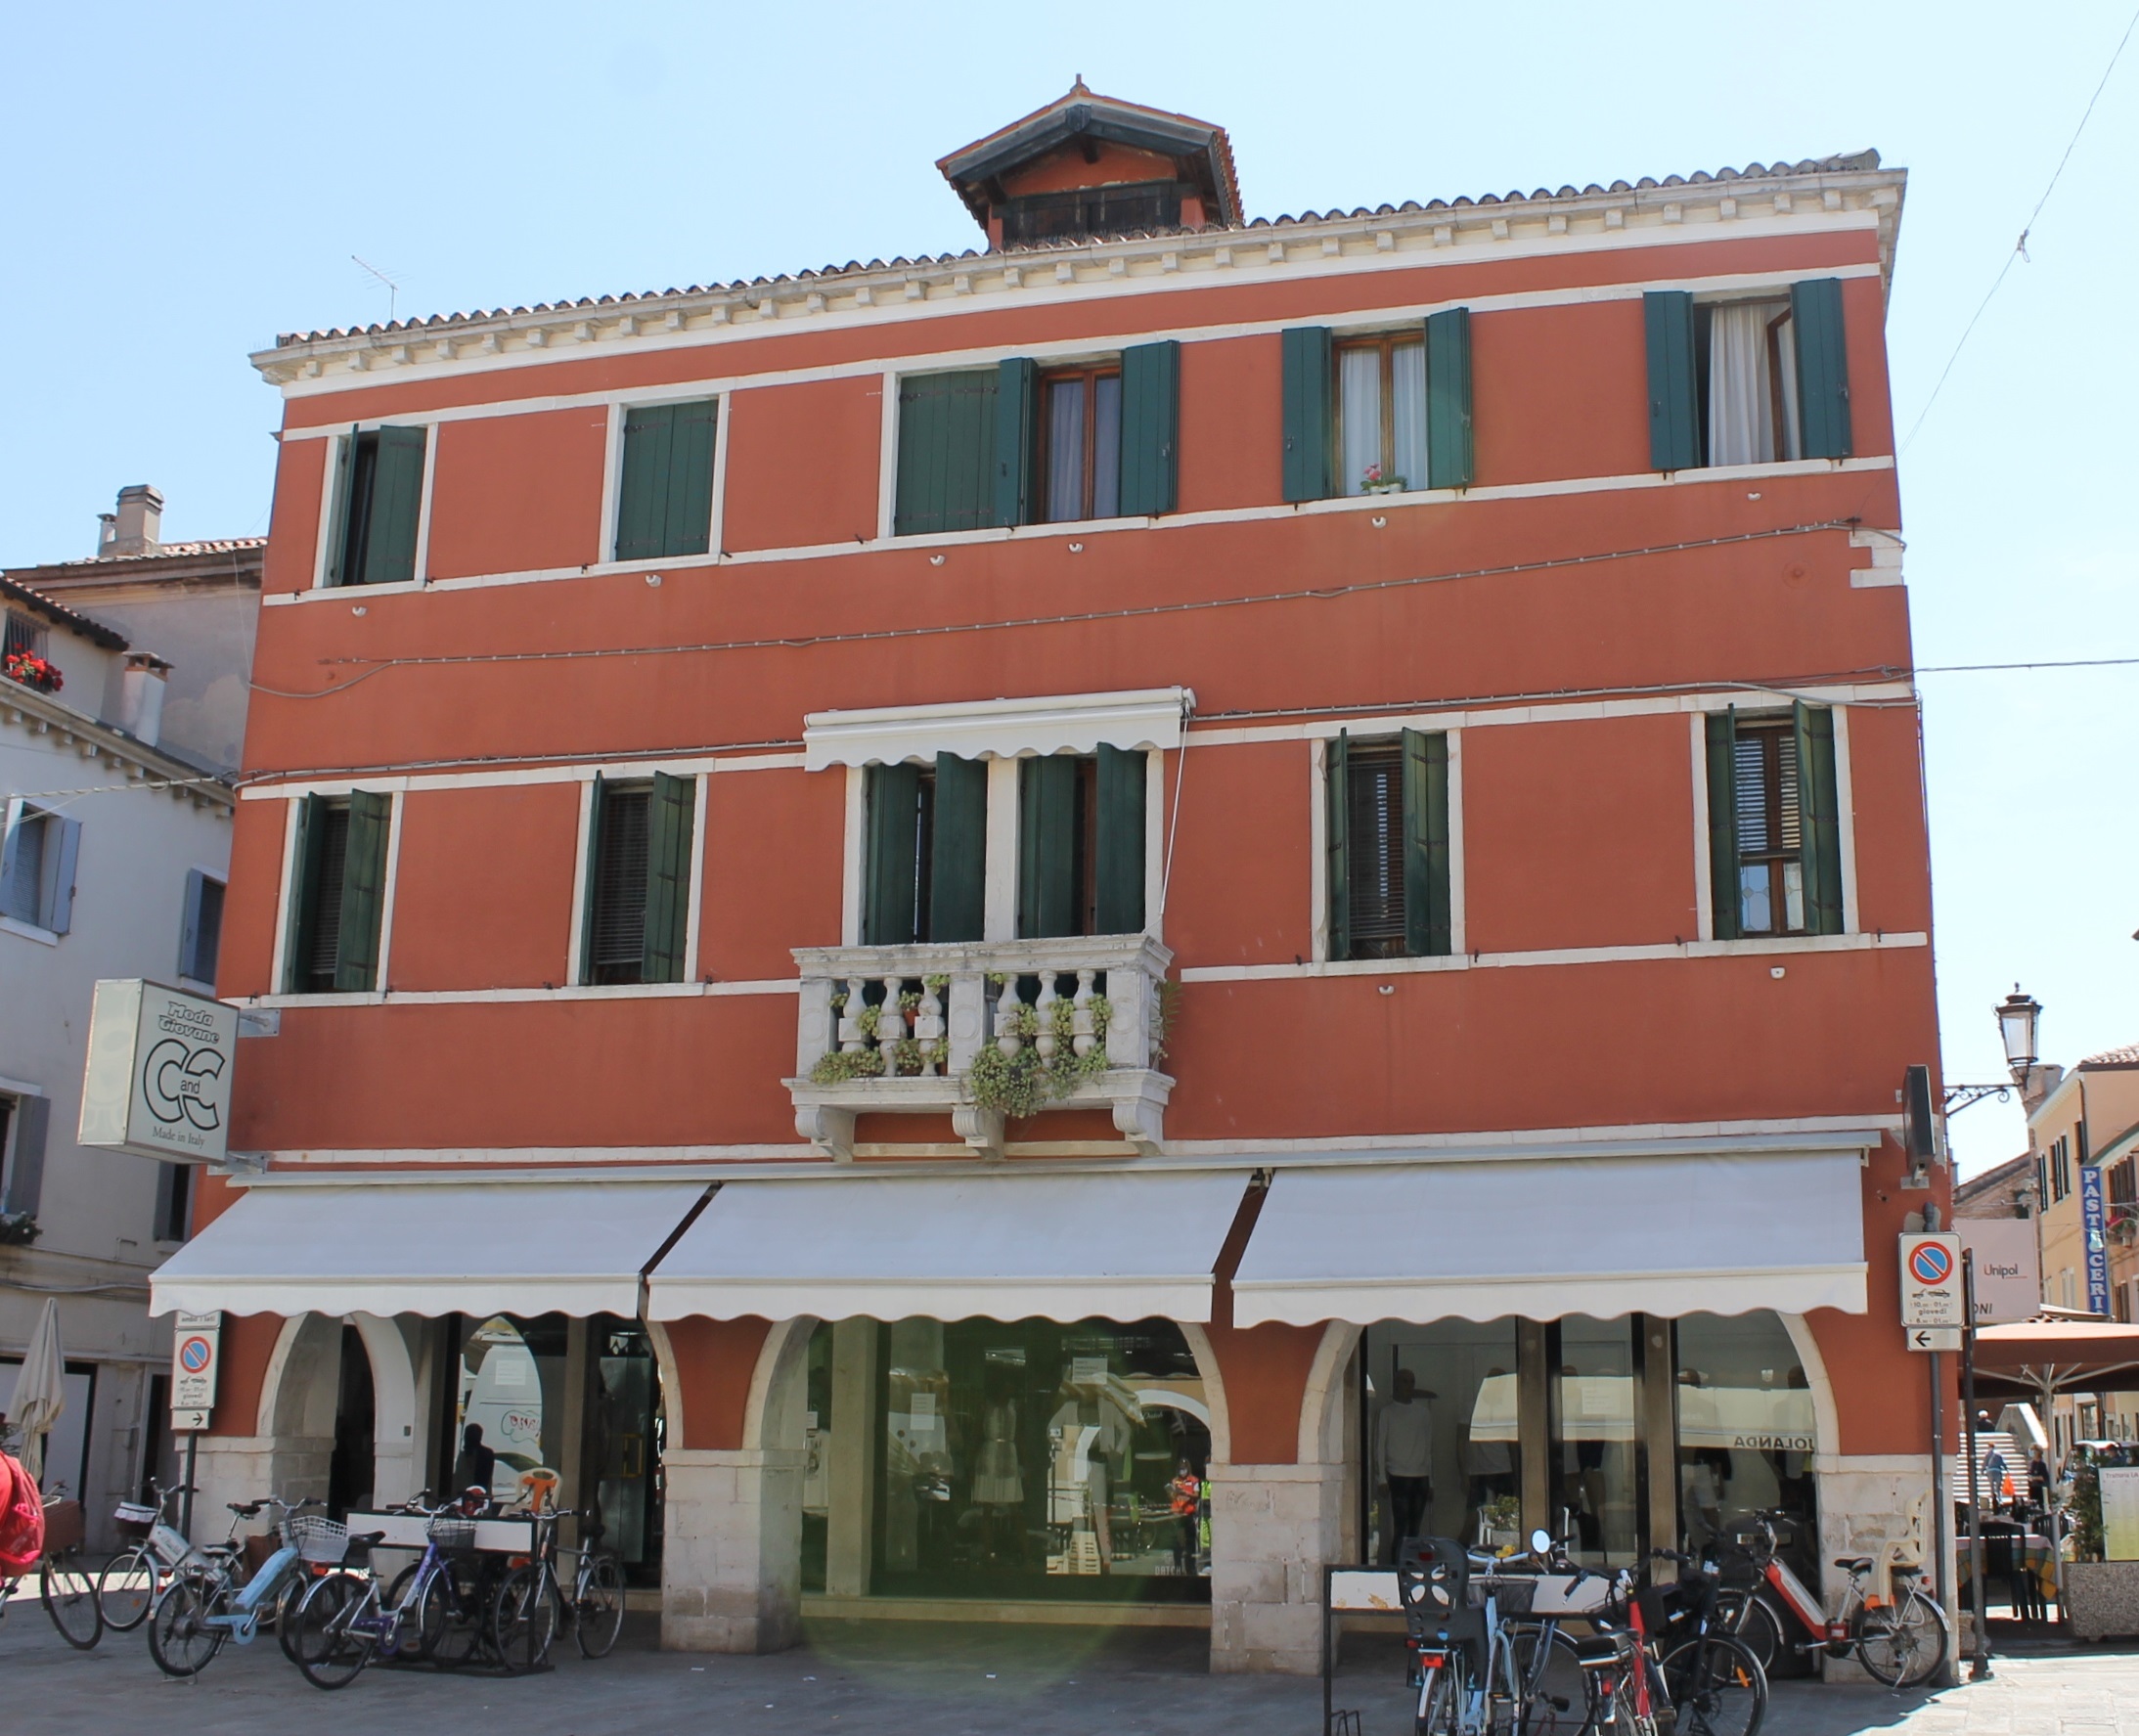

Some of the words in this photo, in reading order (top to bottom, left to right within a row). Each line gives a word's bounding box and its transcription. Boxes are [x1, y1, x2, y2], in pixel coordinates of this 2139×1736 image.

[168, 1001, 213, 1027] Moda
[158, 1015, 220, 1045] Giovane
[180, 1079, 200, 1094] and
[153, 1126, 175, 1142] Made
[177, 1131, 187, 1142] in
[188, 1133, 205, 1149] Italy
[1983, 1263, 2018, 1279] Unipol
